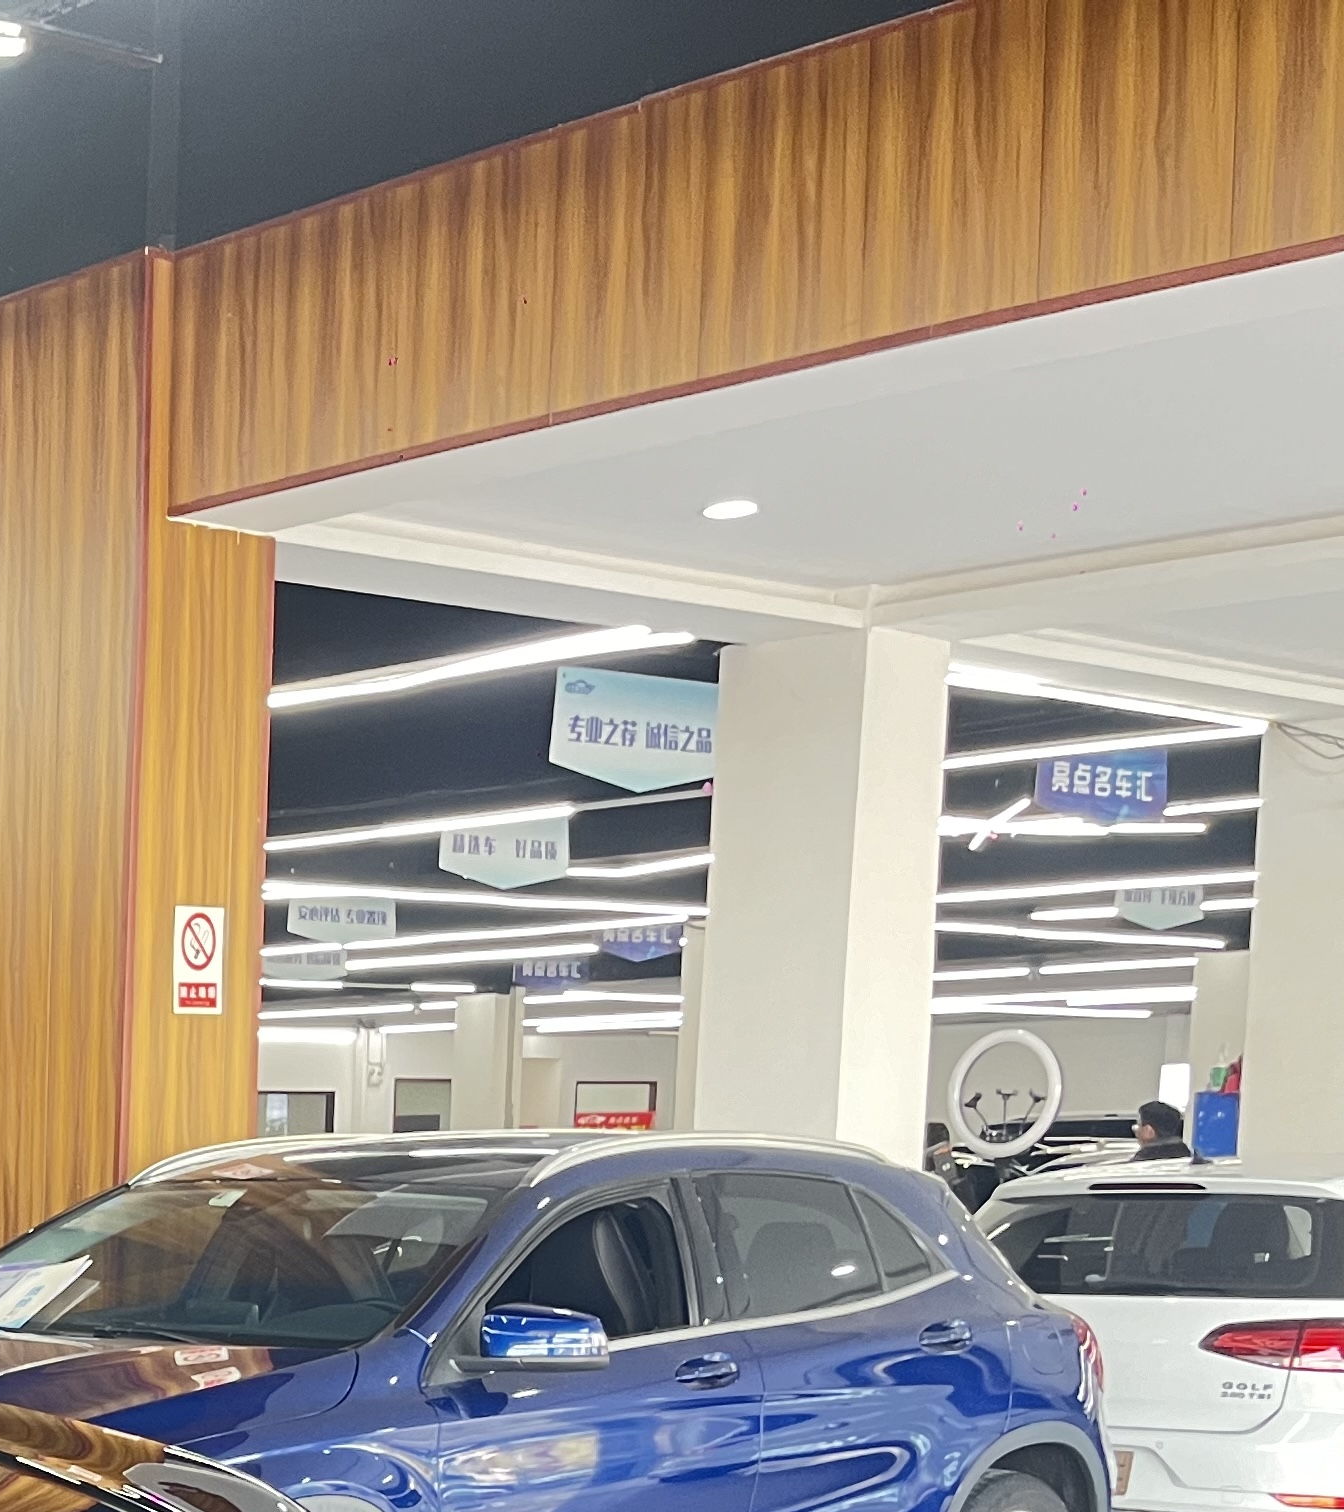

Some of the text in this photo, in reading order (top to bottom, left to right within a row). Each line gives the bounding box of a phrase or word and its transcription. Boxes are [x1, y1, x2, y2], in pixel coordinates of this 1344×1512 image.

[567, 714, 712, 754] 专业之荐 诚信之品
[1052, 761, 1153, 802] 亮点名车汇
[1221, 1381, 1274, 1392] GOLF
